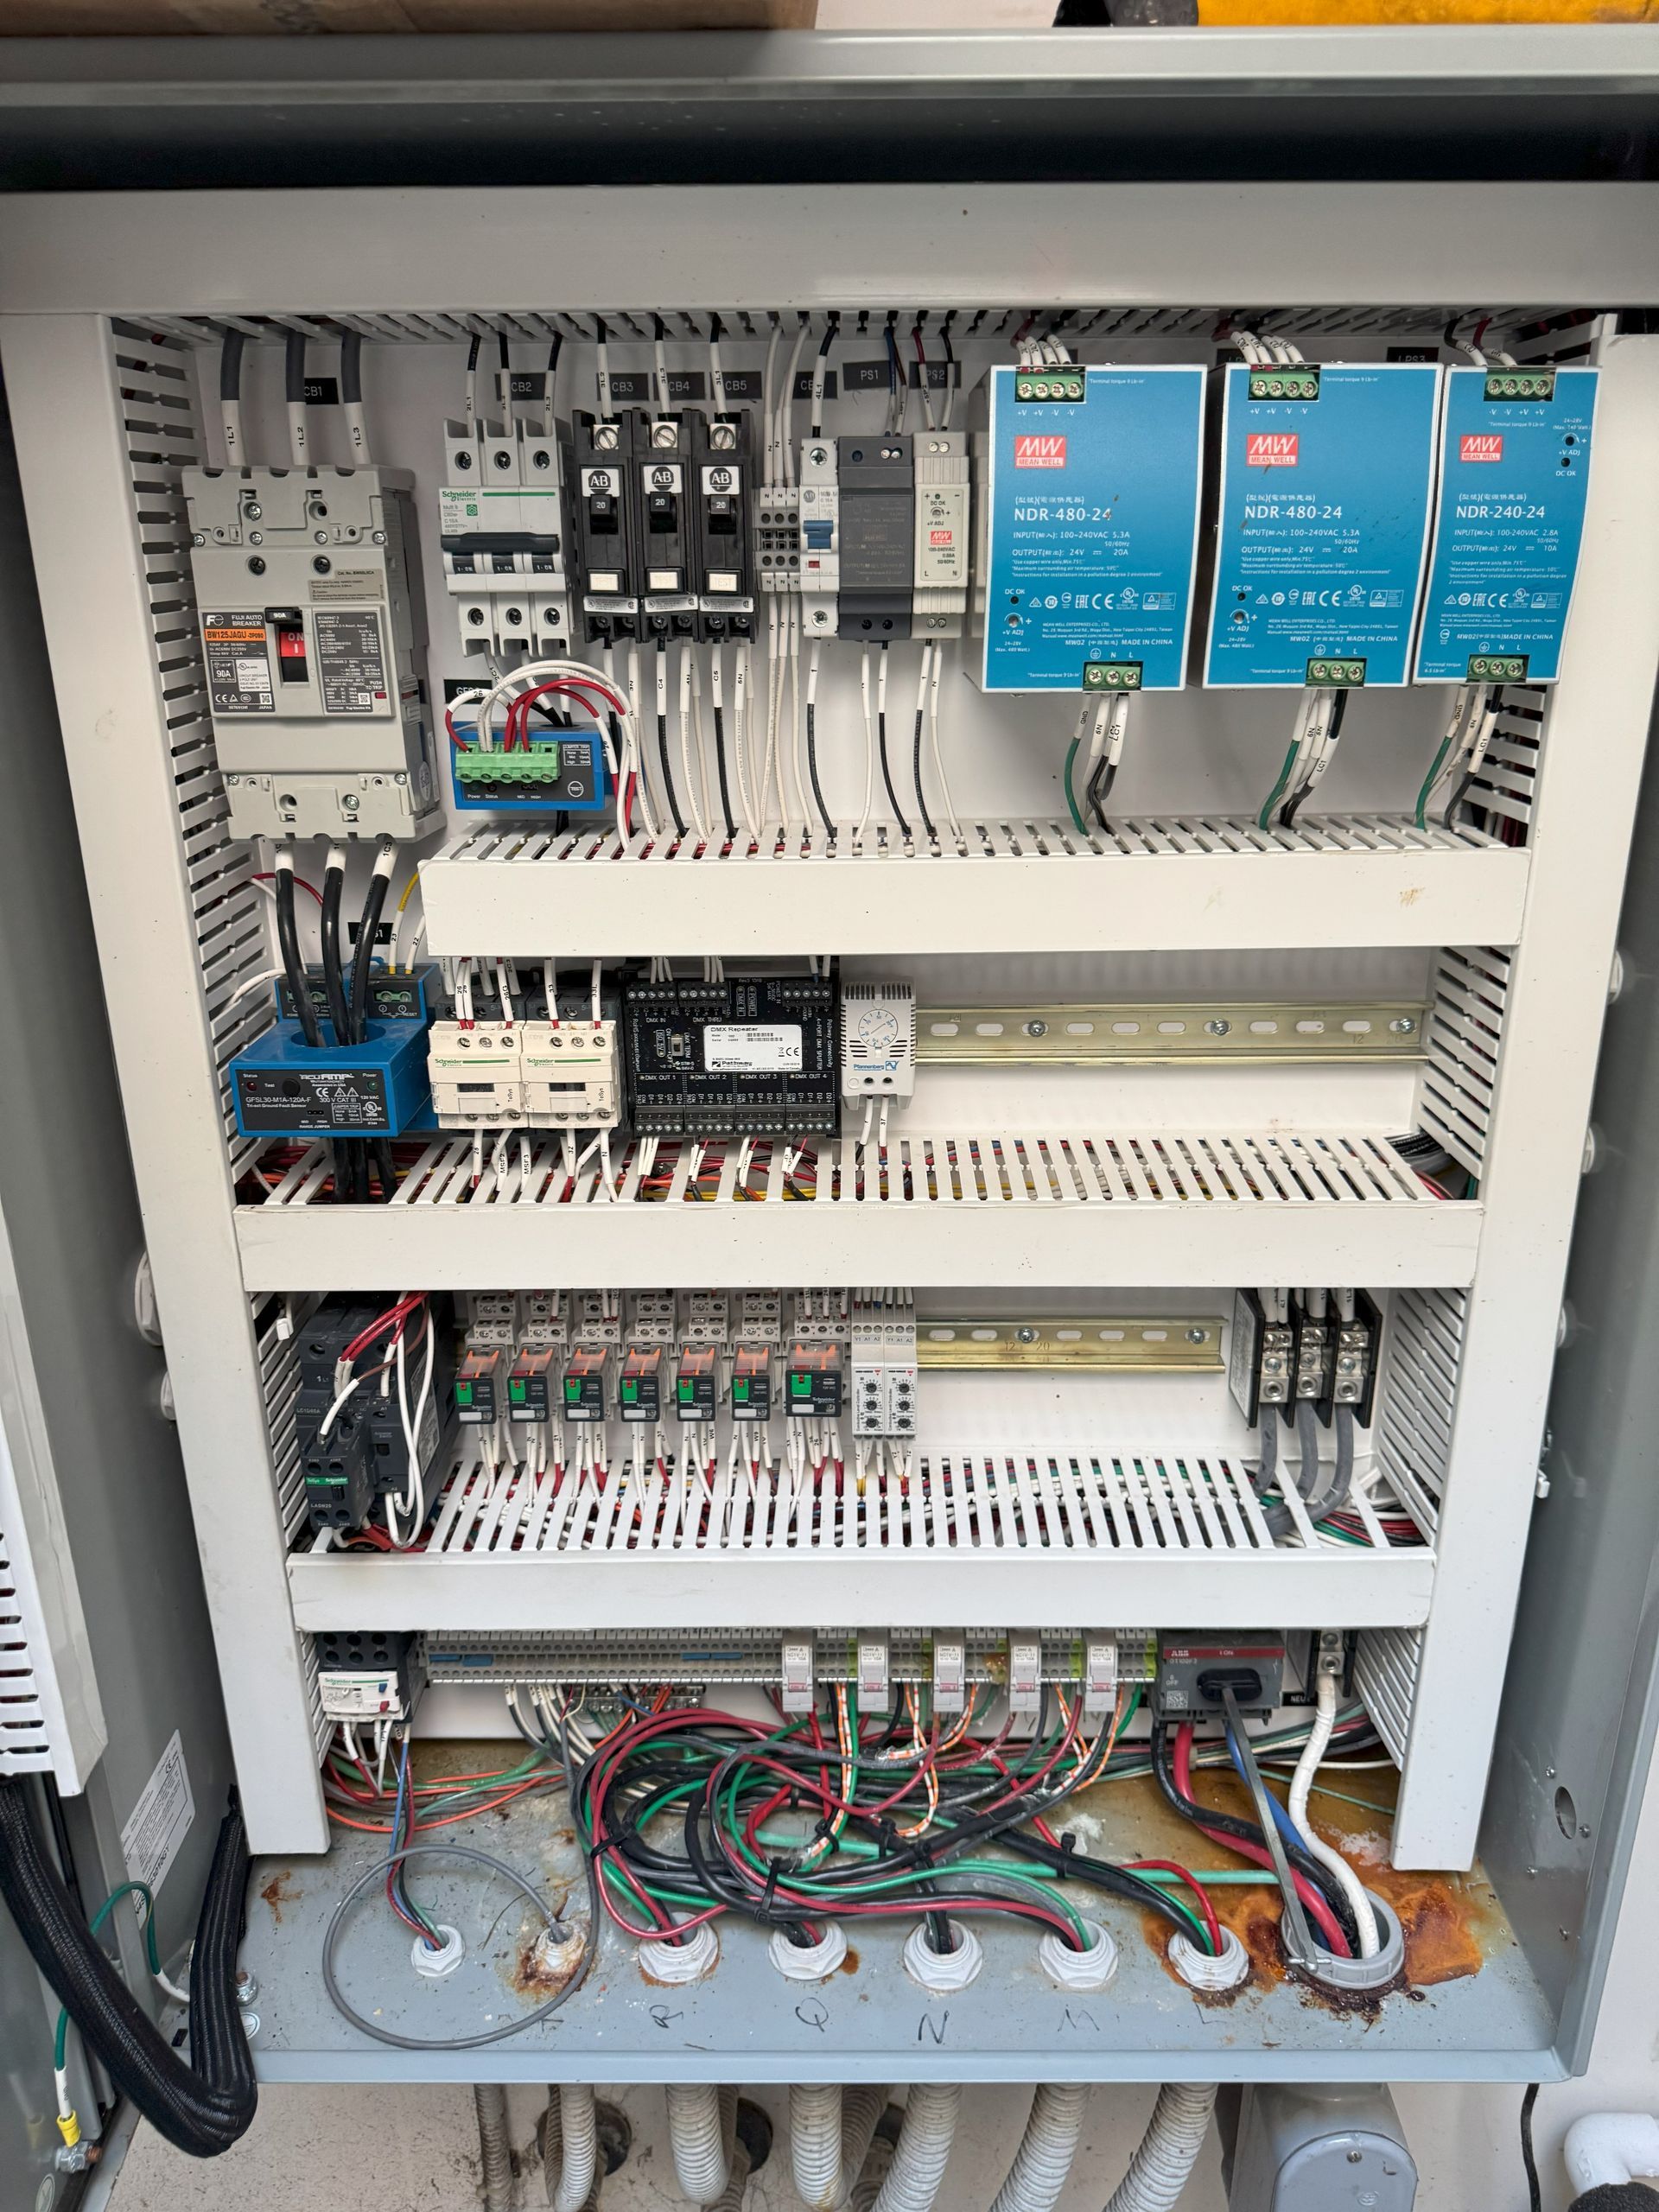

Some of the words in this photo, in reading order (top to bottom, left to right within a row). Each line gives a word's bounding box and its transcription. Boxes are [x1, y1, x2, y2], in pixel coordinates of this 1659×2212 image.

[860, 370, 879, 381] PS1
[303, 385, 323, 398] CB1
[511, 382, 532, 392] CB2
[612, 382, 633, 392] CB3
[669, 381, 690, 391] CB4
[725, 380, 747, 391] CB5
[227, 425, 236, 447] 1L1
[1017, 438, 1064, 456] MW
[1250, 436, 1296, 454] MW
[1463, 437, 1500, 451] MW
[590, 475, 608, 487] AB
[653, 471, 671, 483] AB
[711, 472, 730, 484] AB
[442, 491, 476, 499] Schneider
[1014, 508, 1112, 521] NDR-480-24
[1244, 505, 1342, 518] NDR-480-24
[1456, 506, 1545, 518] NDR-240-24
[932, 531, 950, 540] MW
[288, 632, 304, 641] ON
[794, 1997, 830, 2033] Q
[918, 2010, 950, 2045] N
